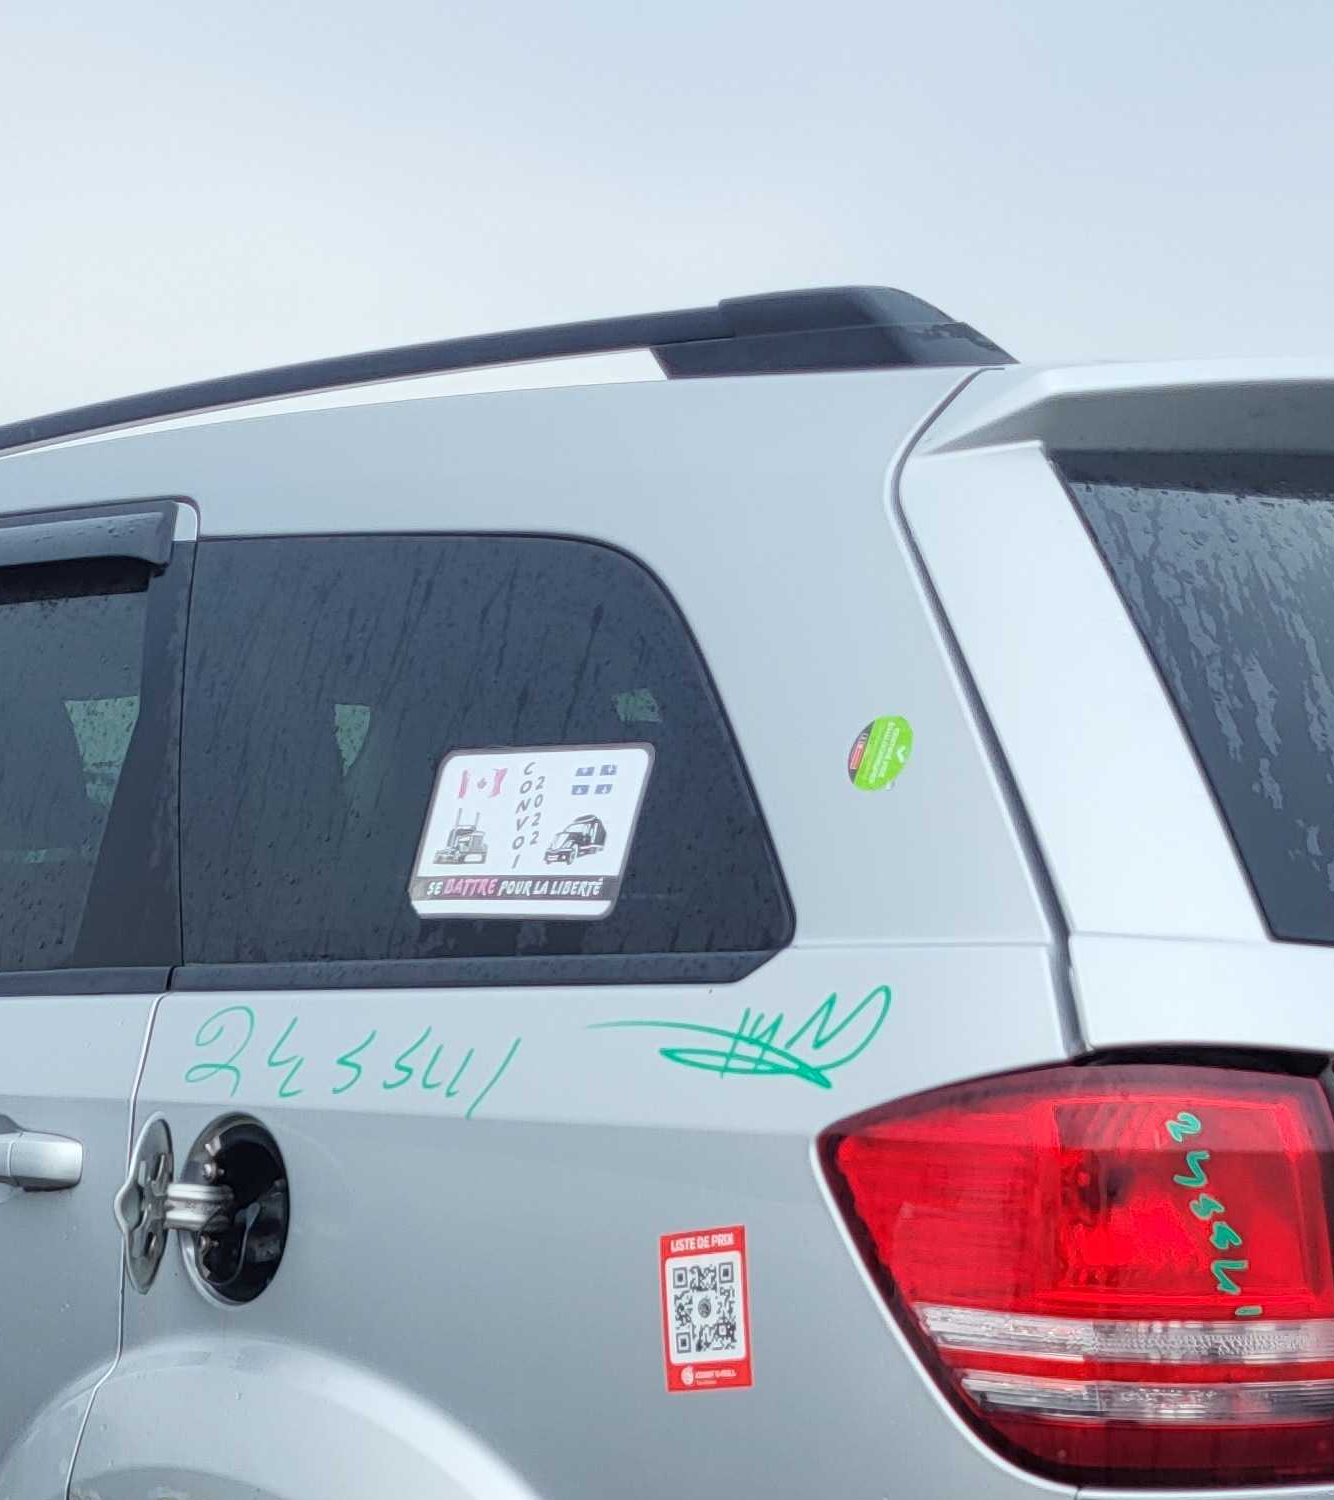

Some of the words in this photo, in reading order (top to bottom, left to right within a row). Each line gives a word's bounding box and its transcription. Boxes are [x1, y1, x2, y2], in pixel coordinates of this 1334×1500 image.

[427, 881, 443, 896] SE
[443, 878, 499, 897] BATTRE
[497, 880, 531, 897] POUR
[531, 880, 551, 896] LA
[551, 877, 604, 897] LIBERTÉ
[697, 1235, 710, 1249] DE
